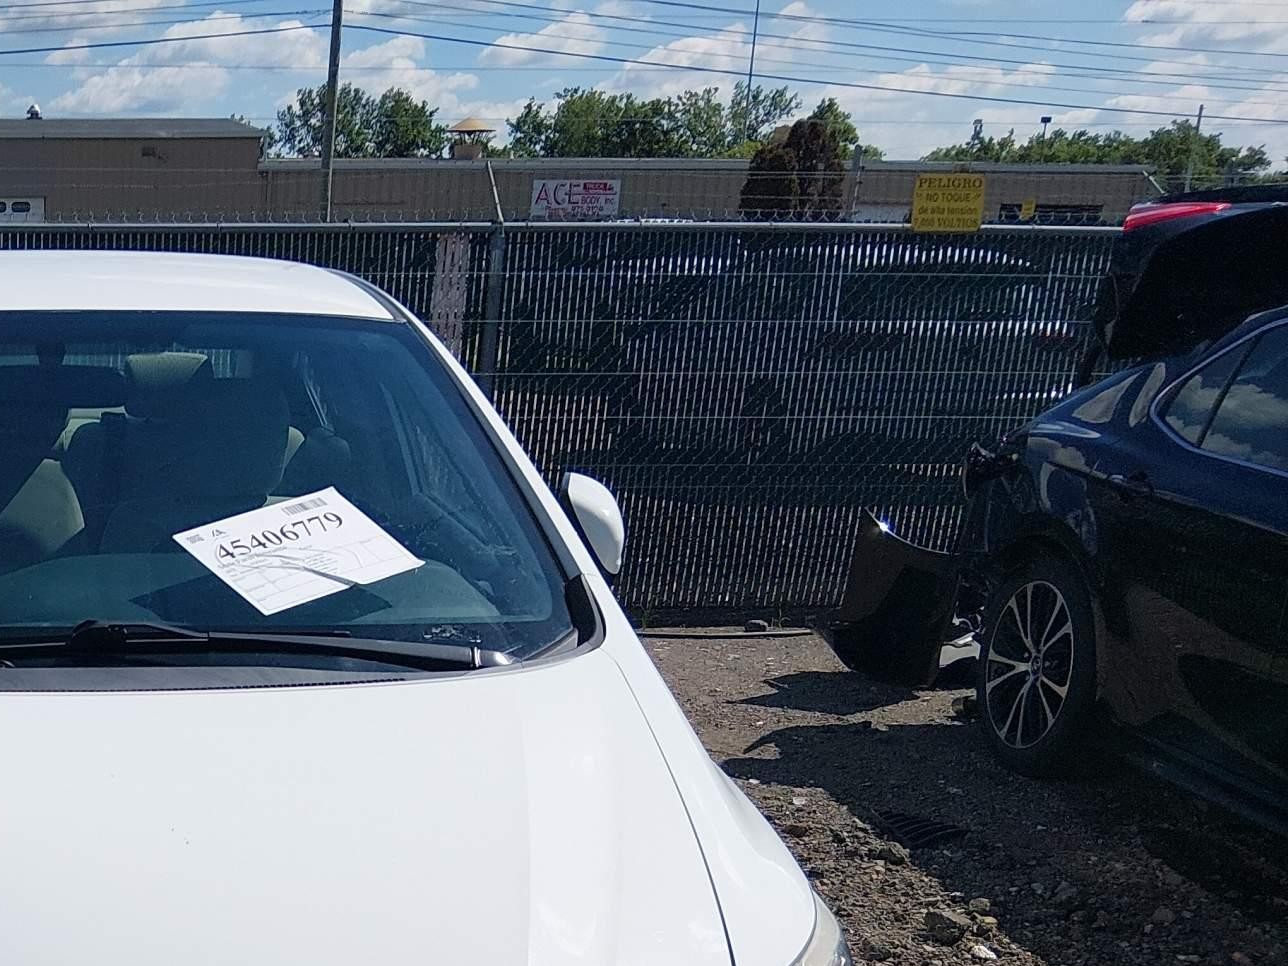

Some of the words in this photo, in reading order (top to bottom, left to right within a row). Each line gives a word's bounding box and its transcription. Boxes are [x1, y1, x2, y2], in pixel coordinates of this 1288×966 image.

[918, 177, 983, 189] PELIGRO
[534, 182, 581, 206] ACE
[926, 191, 940, 202] NO
[941, 192, 972, 202] TOQUE
[216, 512, 343, 559] 45406779
